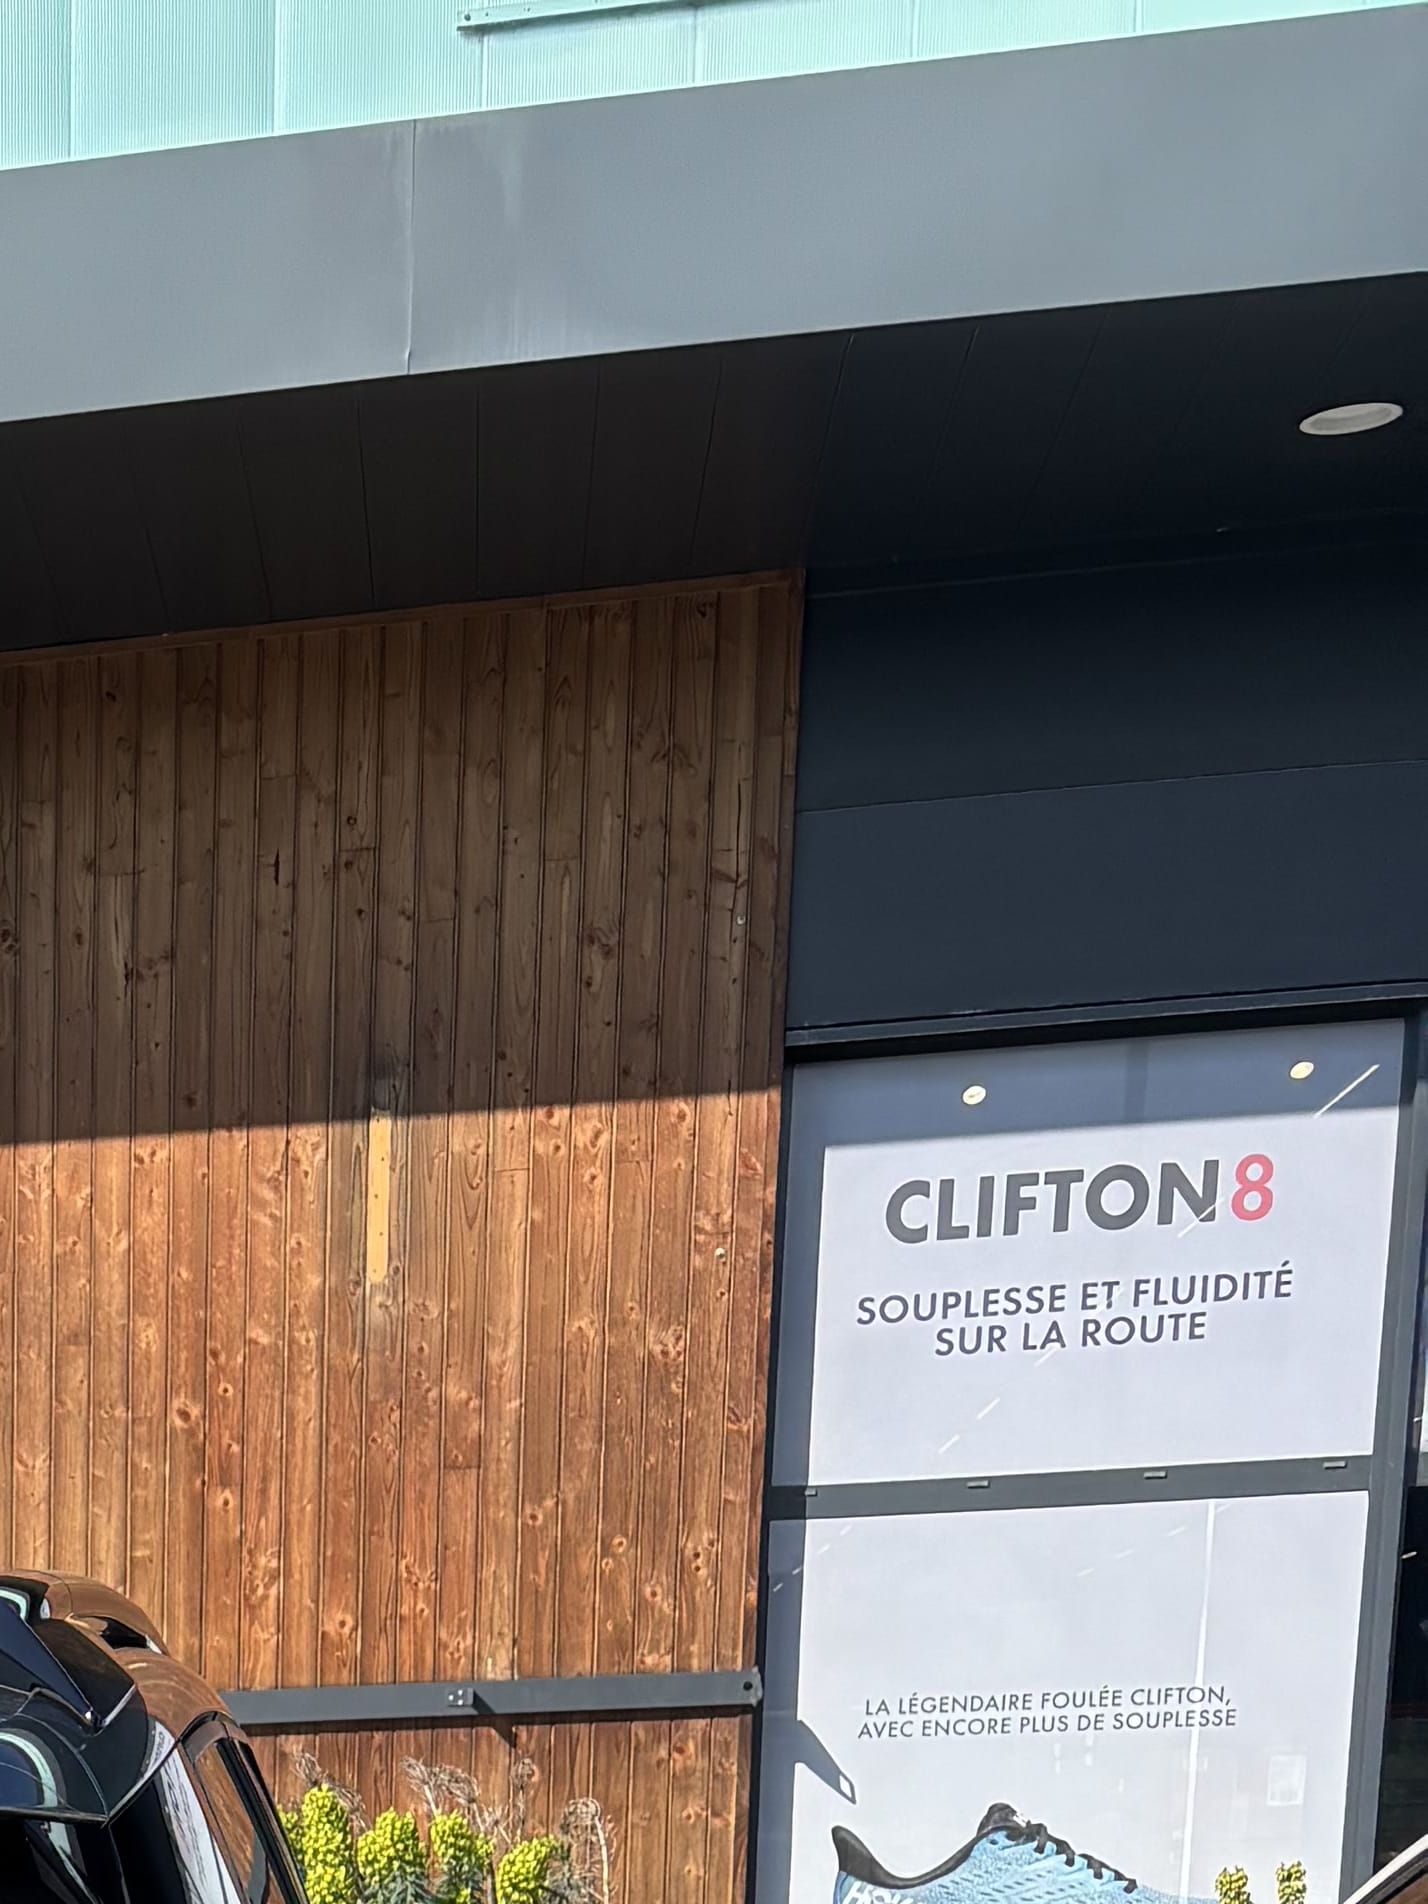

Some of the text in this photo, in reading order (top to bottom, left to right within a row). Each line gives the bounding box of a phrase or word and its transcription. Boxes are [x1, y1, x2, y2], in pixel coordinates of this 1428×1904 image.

[857, 1260, 1293, 1325] SOUPLESSE ET FLUIDITÉ
[935, 1312, 1207, 1356] SUR LA ROUTE
[865, 1685, 1230, 1716] LA LÉGENDAIRE FOULÉE CLIFTON,
[858, 1709, 1237, 1739] AVEC ENCORE PLUS DE SOUPLESSE
